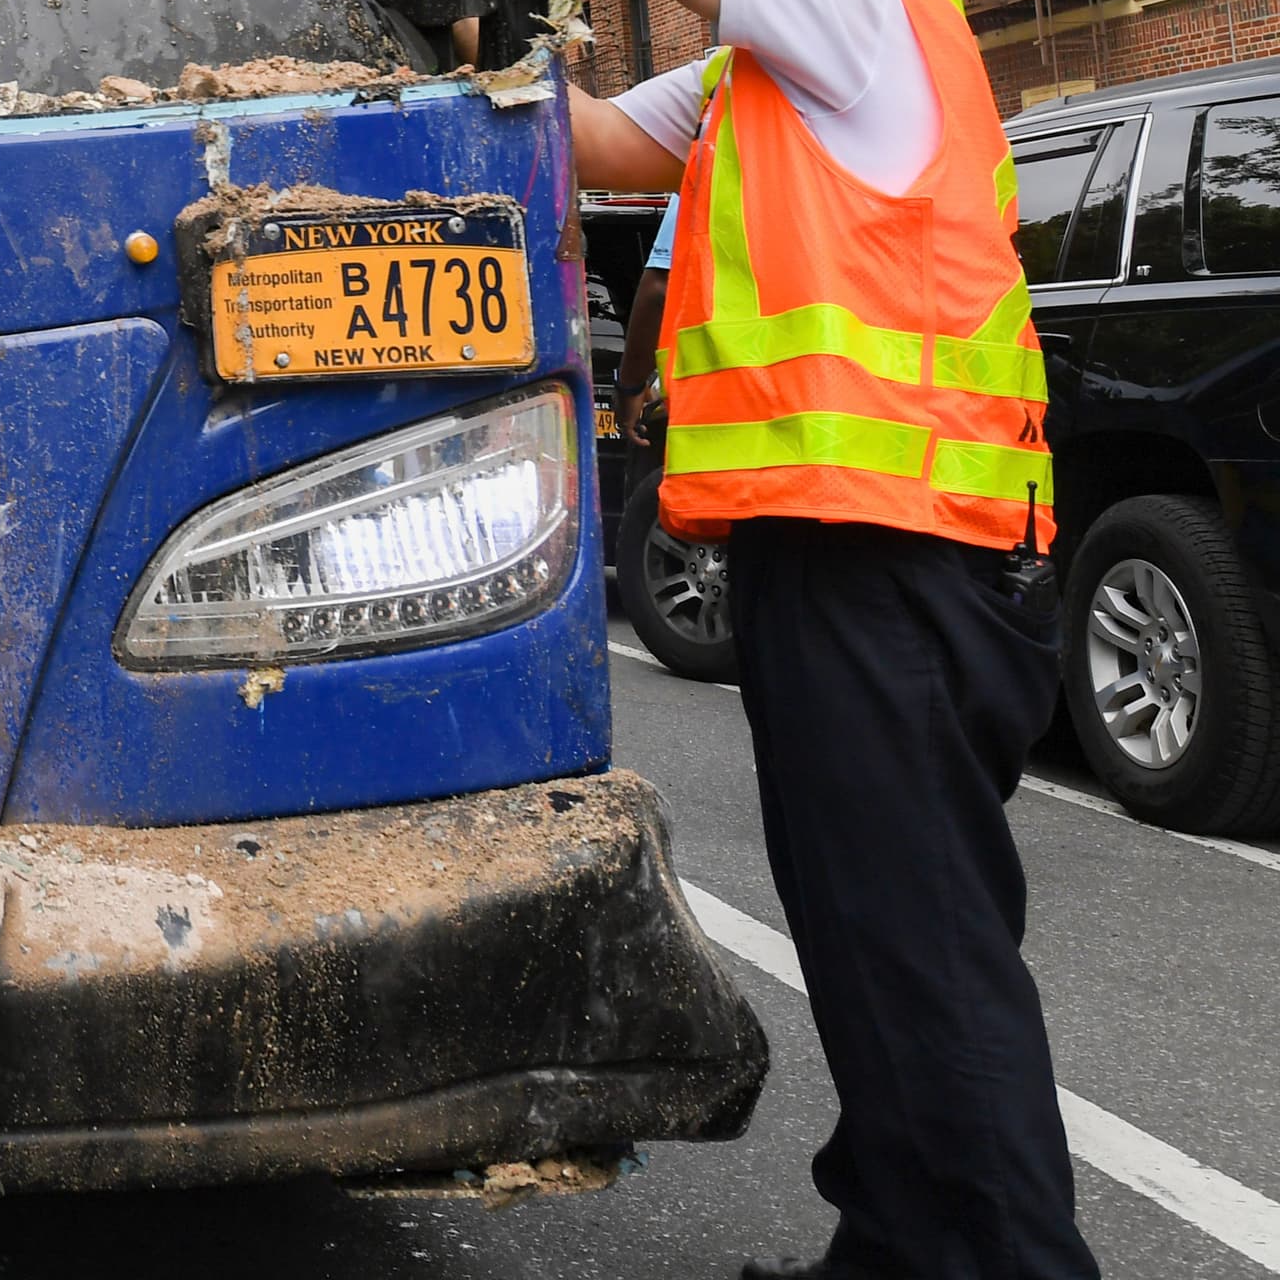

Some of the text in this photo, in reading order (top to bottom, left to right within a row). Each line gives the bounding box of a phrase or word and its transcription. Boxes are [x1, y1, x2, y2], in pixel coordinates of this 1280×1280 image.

[284, 221, 445, 251] NEW YORK
[227, 269, 323, 288] Metropolitan
[223, 295, 333, 315] Trnsportation
[382, 256, 509, 339] 4738
[314, 344, 435, 368] NEW YORK
